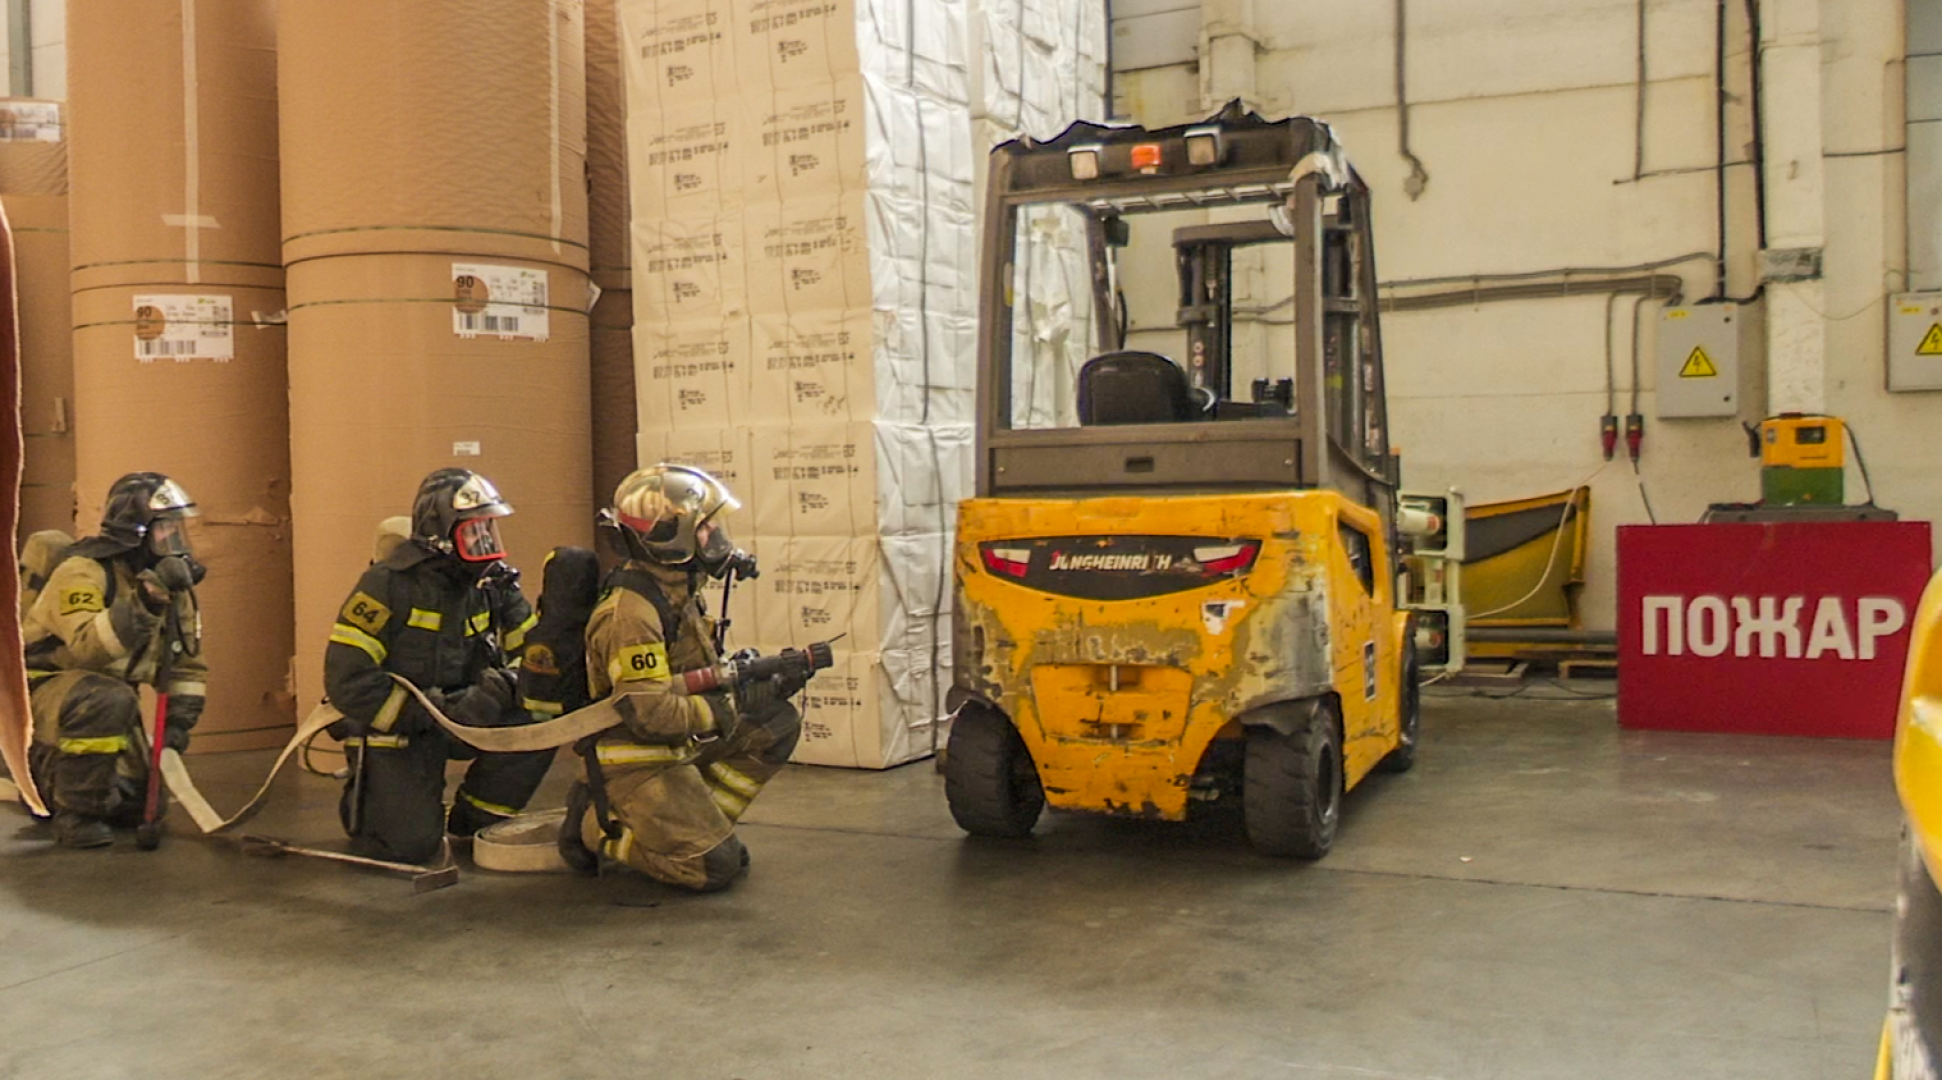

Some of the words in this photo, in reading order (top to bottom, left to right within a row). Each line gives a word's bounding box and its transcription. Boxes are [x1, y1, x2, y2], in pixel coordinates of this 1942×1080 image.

[457, 276, 474, 288] 90
[1048, 550, 1172, 570] JUNGHEINRIH
[68, 592, 94, 606] 62
[352, 602, 380, 624] 64
[1642, 595, 1906, 660] ПОЖАР
[631, 652, 657, 671] 60
